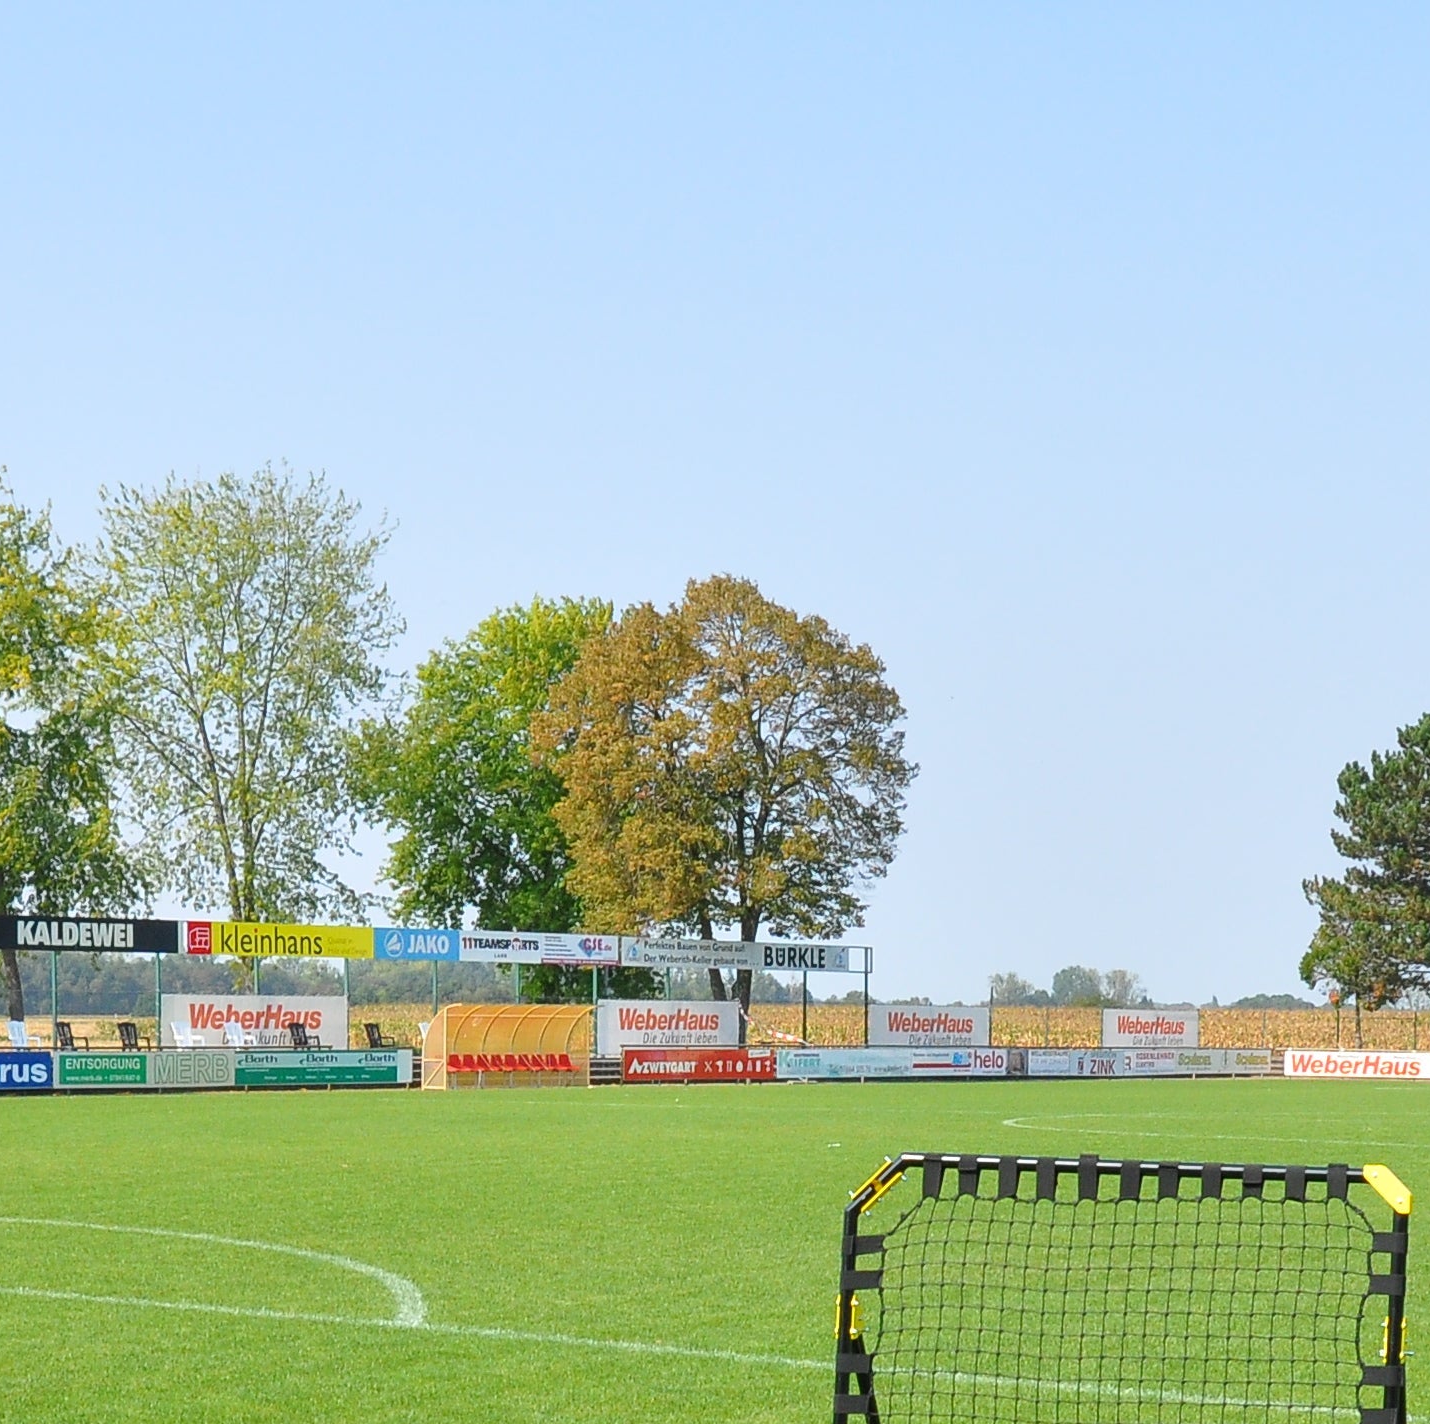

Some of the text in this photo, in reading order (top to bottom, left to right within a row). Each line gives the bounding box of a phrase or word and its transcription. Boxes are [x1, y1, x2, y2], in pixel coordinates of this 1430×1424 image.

[17, 920, 134, 947] KALDEWEI
[221, 925, 323, 954] kleinhans
[407, 934, 450, 954] JAKO
[644, 940, 675, 950] Perfektes
[677, 941, 698, 950] Bauen
[644, 953, 656, 962] Der
[764, 946, 826, 968] BÜRKLE
[189, 1003, 323, 1030] WeberHaus
[618, 1008, 720, 1031] WeberHaus
[888, 1012, 974, 1033] WeberHaus
[1117, 1016, 1185, 1035] WeberHaus
[643, 1032, 718, 1044] Die Zukunft leben
[908, 1034, 921, 1045] Die
[65, 1058, 140, 1070] ENTSORGUNG
[154, 1053, 229, 1084] MERB
[973, 1049, 1004, 1069] helo
[1090, 1059, 1116, 1075] ZINK
[1291, 1054, 1421, 1076] WeberHaus
